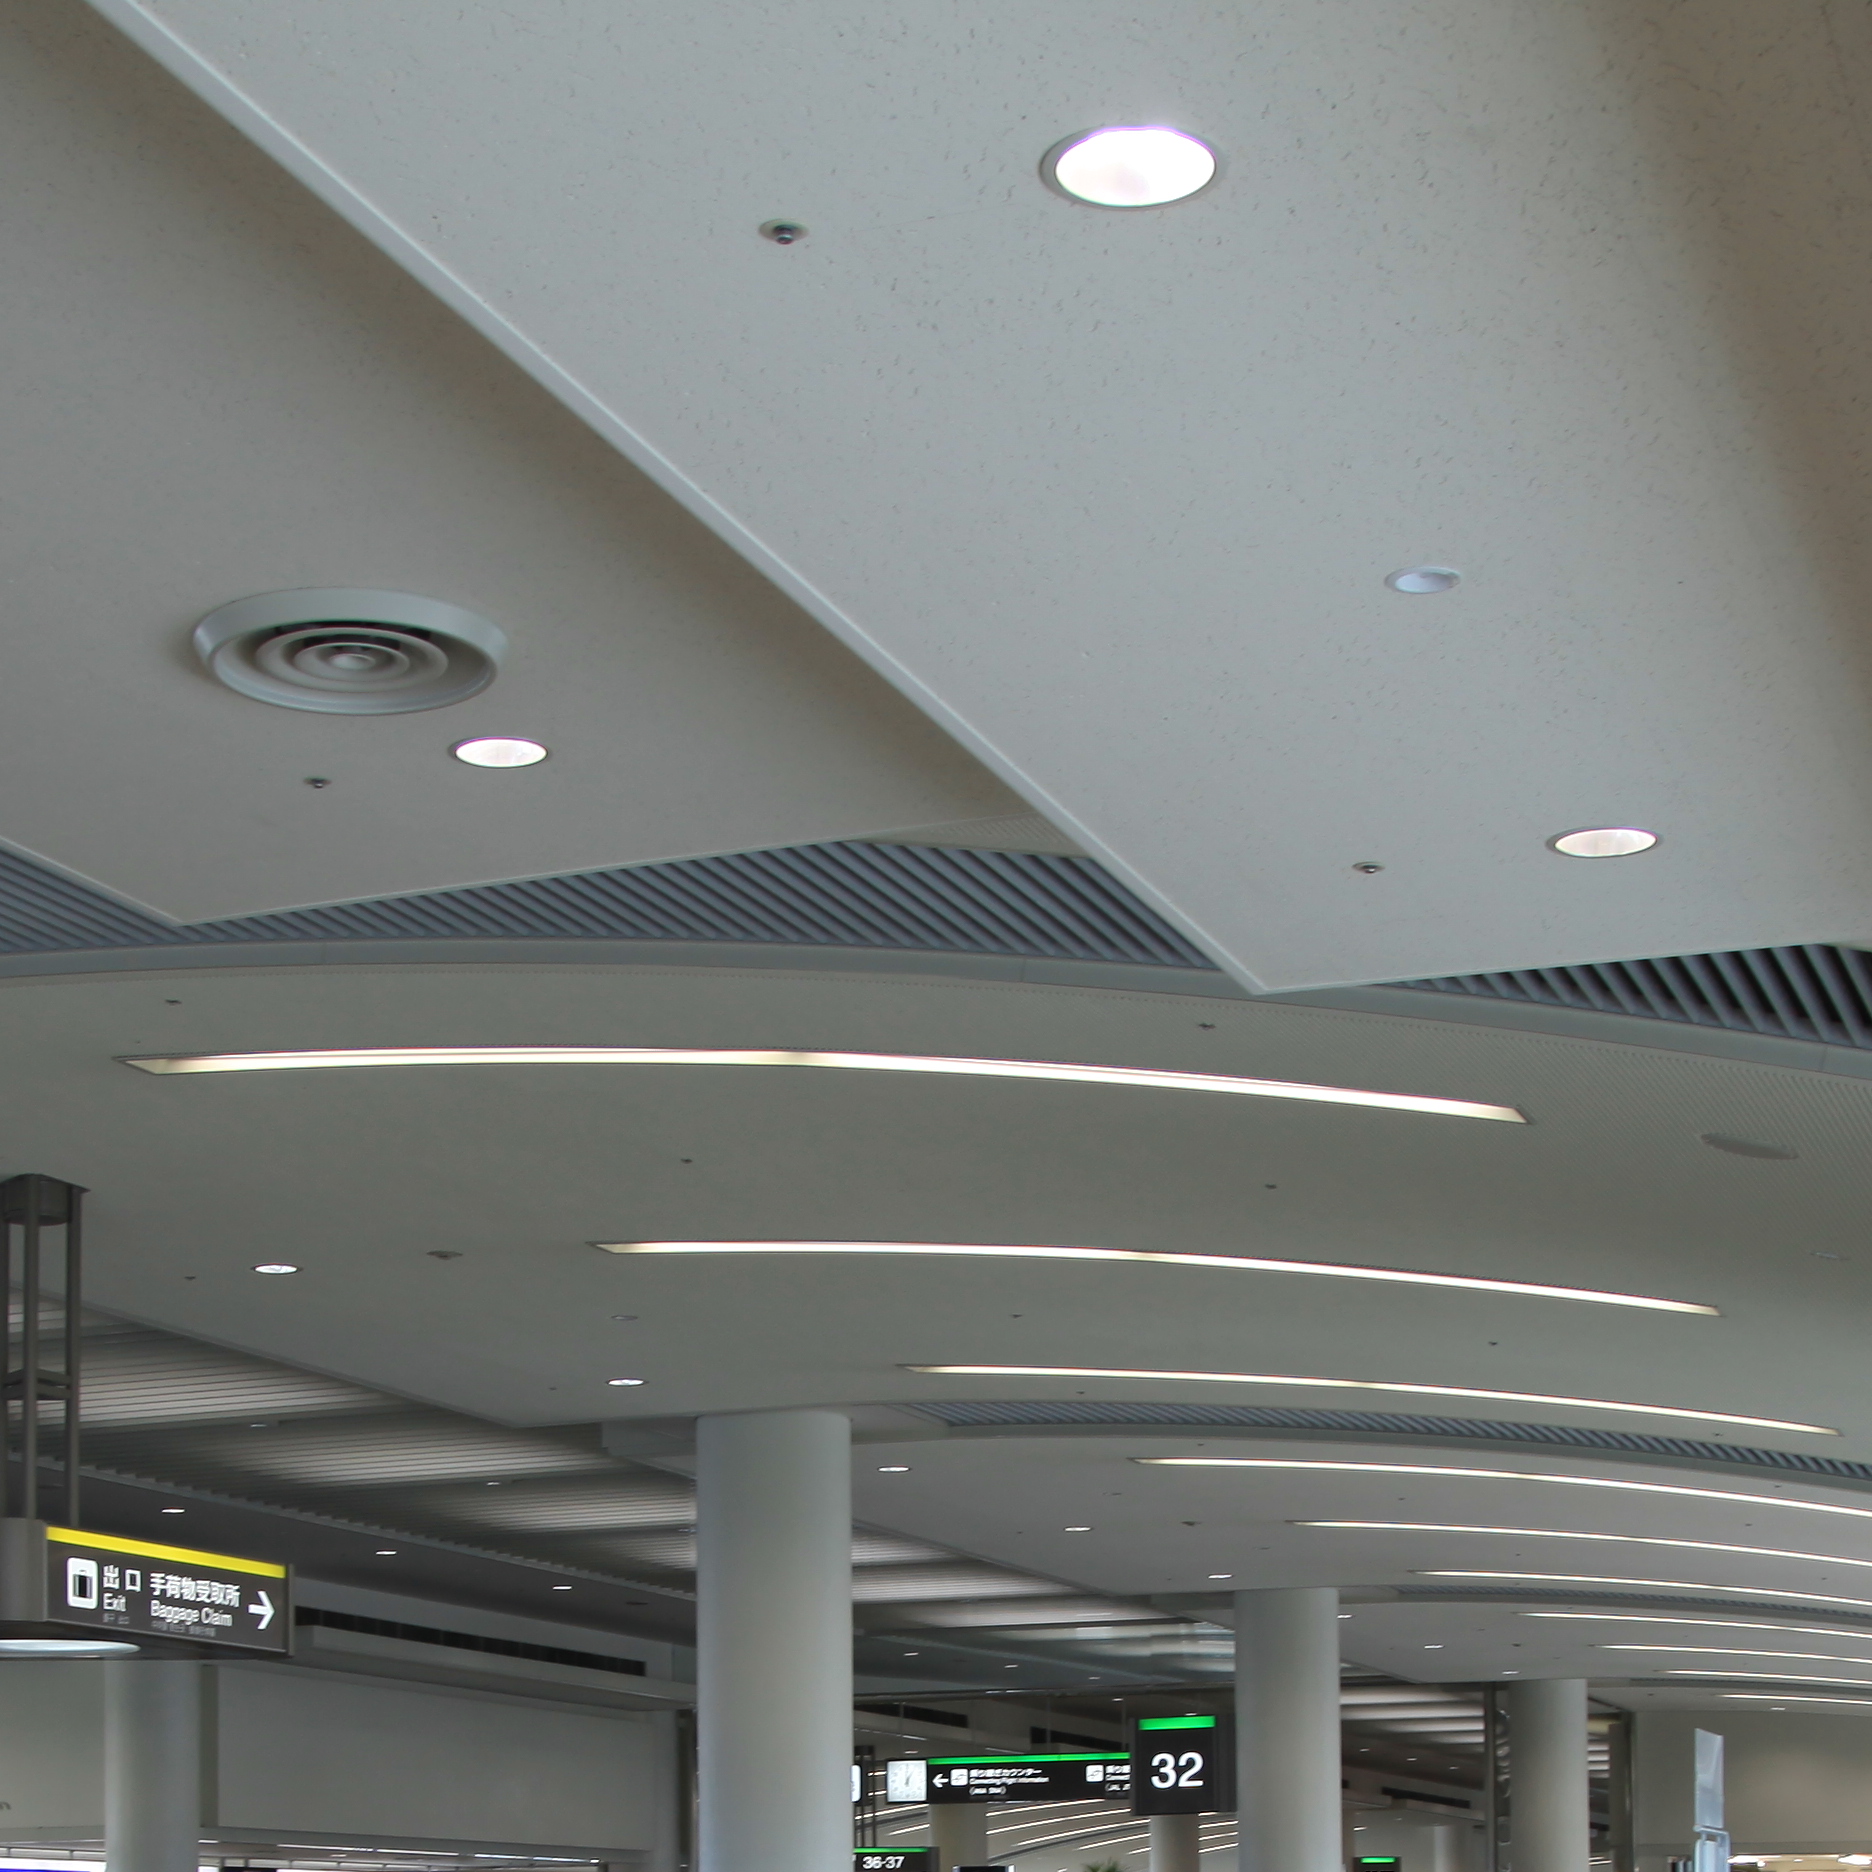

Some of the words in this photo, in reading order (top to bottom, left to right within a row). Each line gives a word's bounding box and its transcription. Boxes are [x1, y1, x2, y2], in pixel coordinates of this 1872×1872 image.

[103, 1564, 141, 1592] 出口
[149, 1572, 241, 1608] 手荷物受取所
[103, 1592, 127, 1612] Exit
[150, 1599, 200, 1626] Baggage
[200, 1607, 233, 1627] Claim
[1150, 1751, 1204, 1789] 32
[862, 1855, 906, 1870] 36-37
